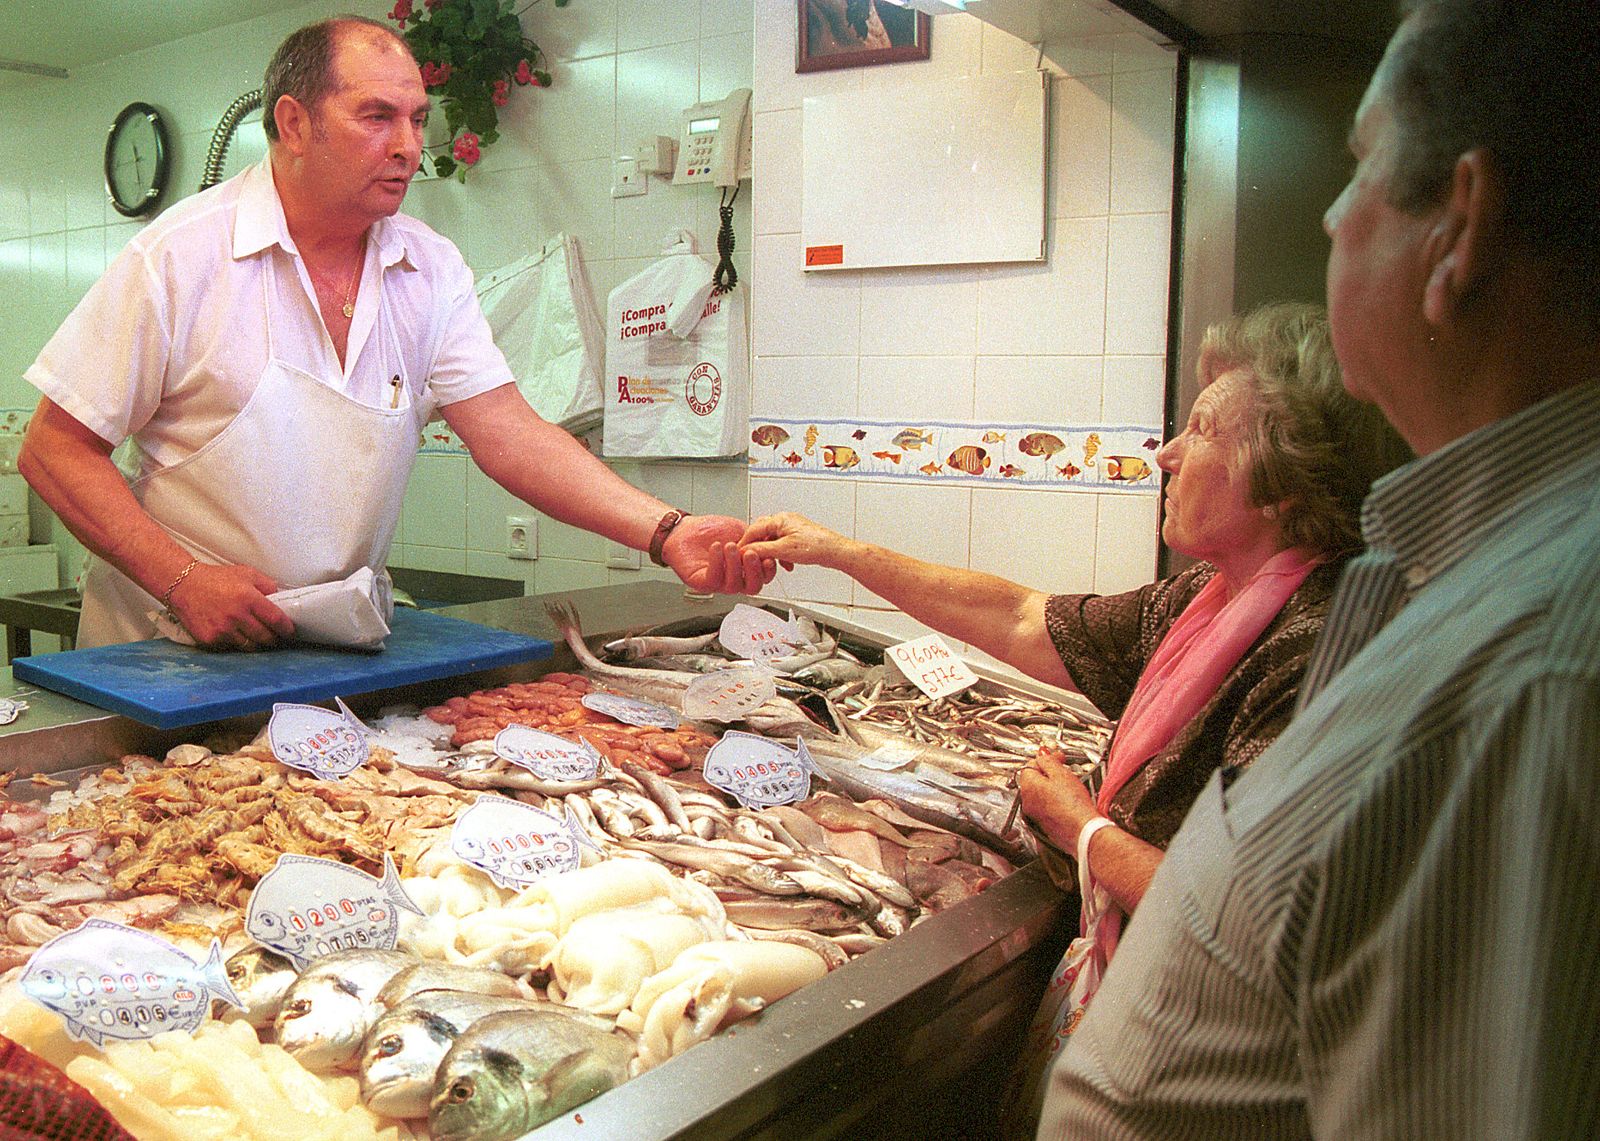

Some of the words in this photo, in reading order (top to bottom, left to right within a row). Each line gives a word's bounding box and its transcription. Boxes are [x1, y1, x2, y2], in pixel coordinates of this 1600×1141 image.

[620, 321, 667, 340] ¡Compra
[700, 299, 721, 319] alle!
[621, 304, 666, 324] ¡Compra
[692, 365, 709, 380] CON
[631, 396, 655, 404] 100%
[490, 833, 545, 856] 1100
[292, 899, 353, 930] 1290
